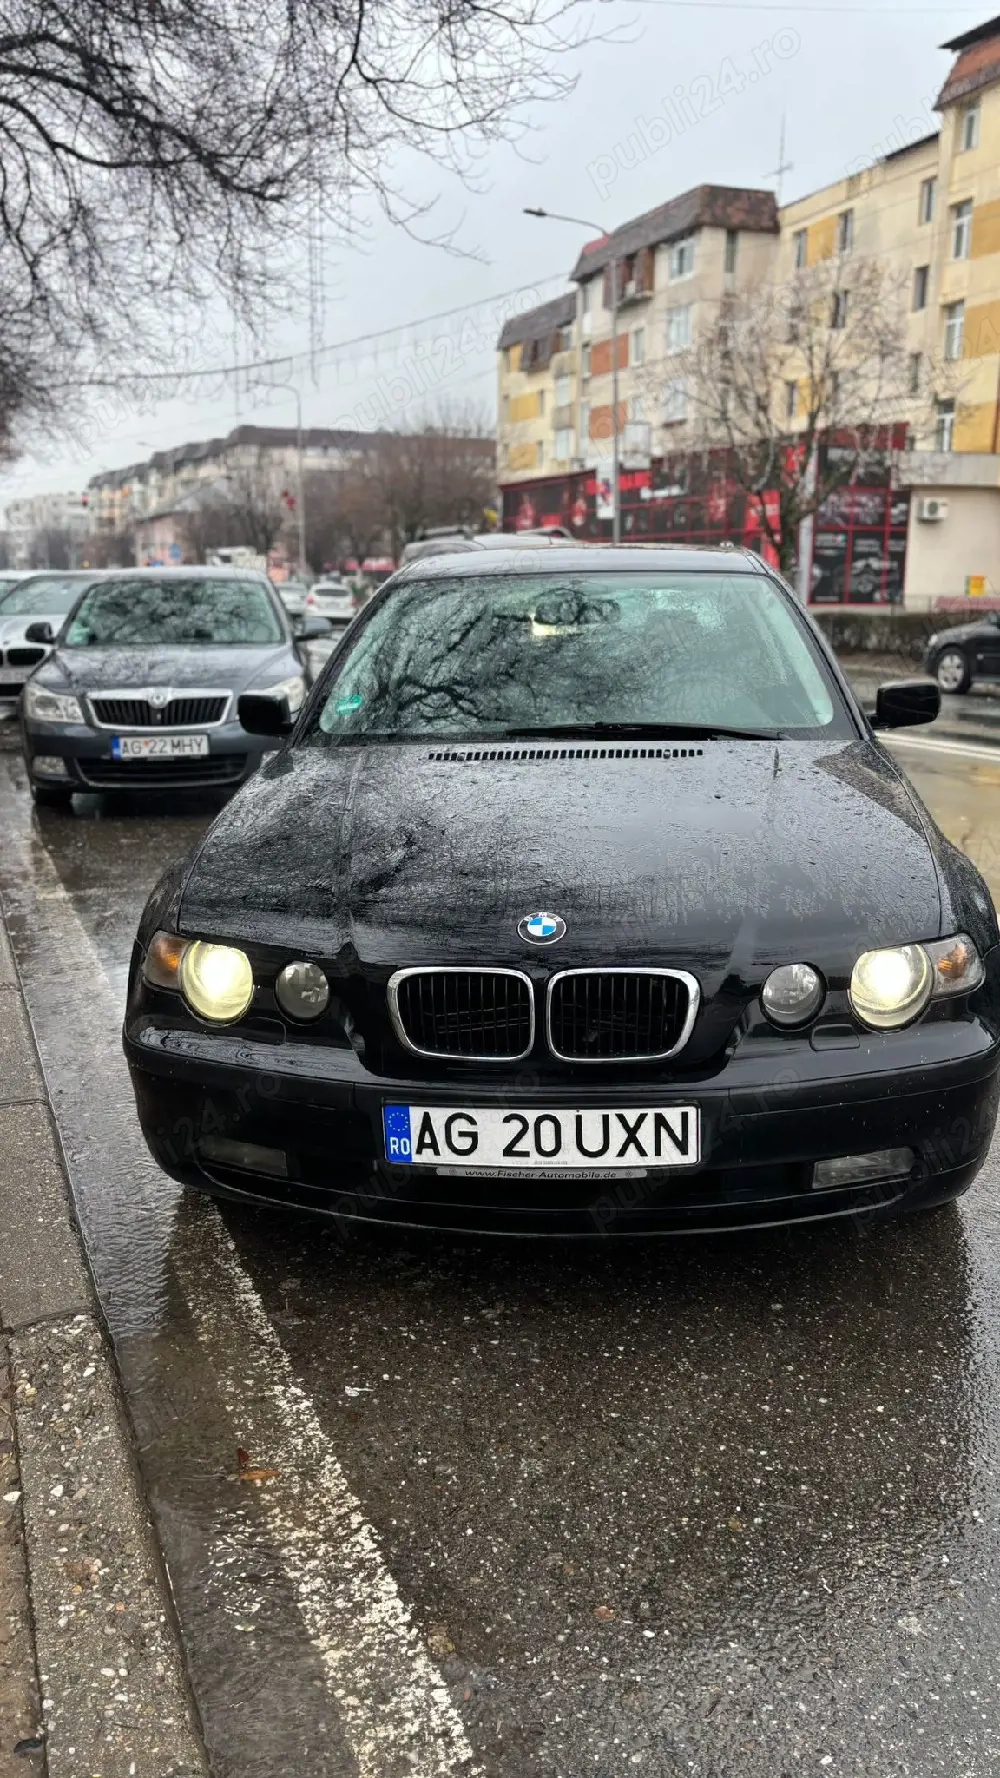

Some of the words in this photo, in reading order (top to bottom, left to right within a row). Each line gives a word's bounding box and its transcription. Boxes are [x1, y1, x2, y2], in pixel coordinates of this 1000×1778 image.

[122, 740, 142, 755] AG
[148, 739, 168, 754] 22
[171, 738, 203, 753] MHY
[416, 1111, 478, 1157] AG
[502, 1114, 562, 1157] 20
[575, 1112, 689, 1158] UXN
[390, 1137, 411, 1155] RO
[464, 1169, 617, 1180] www.Fischer-Automobile.de
